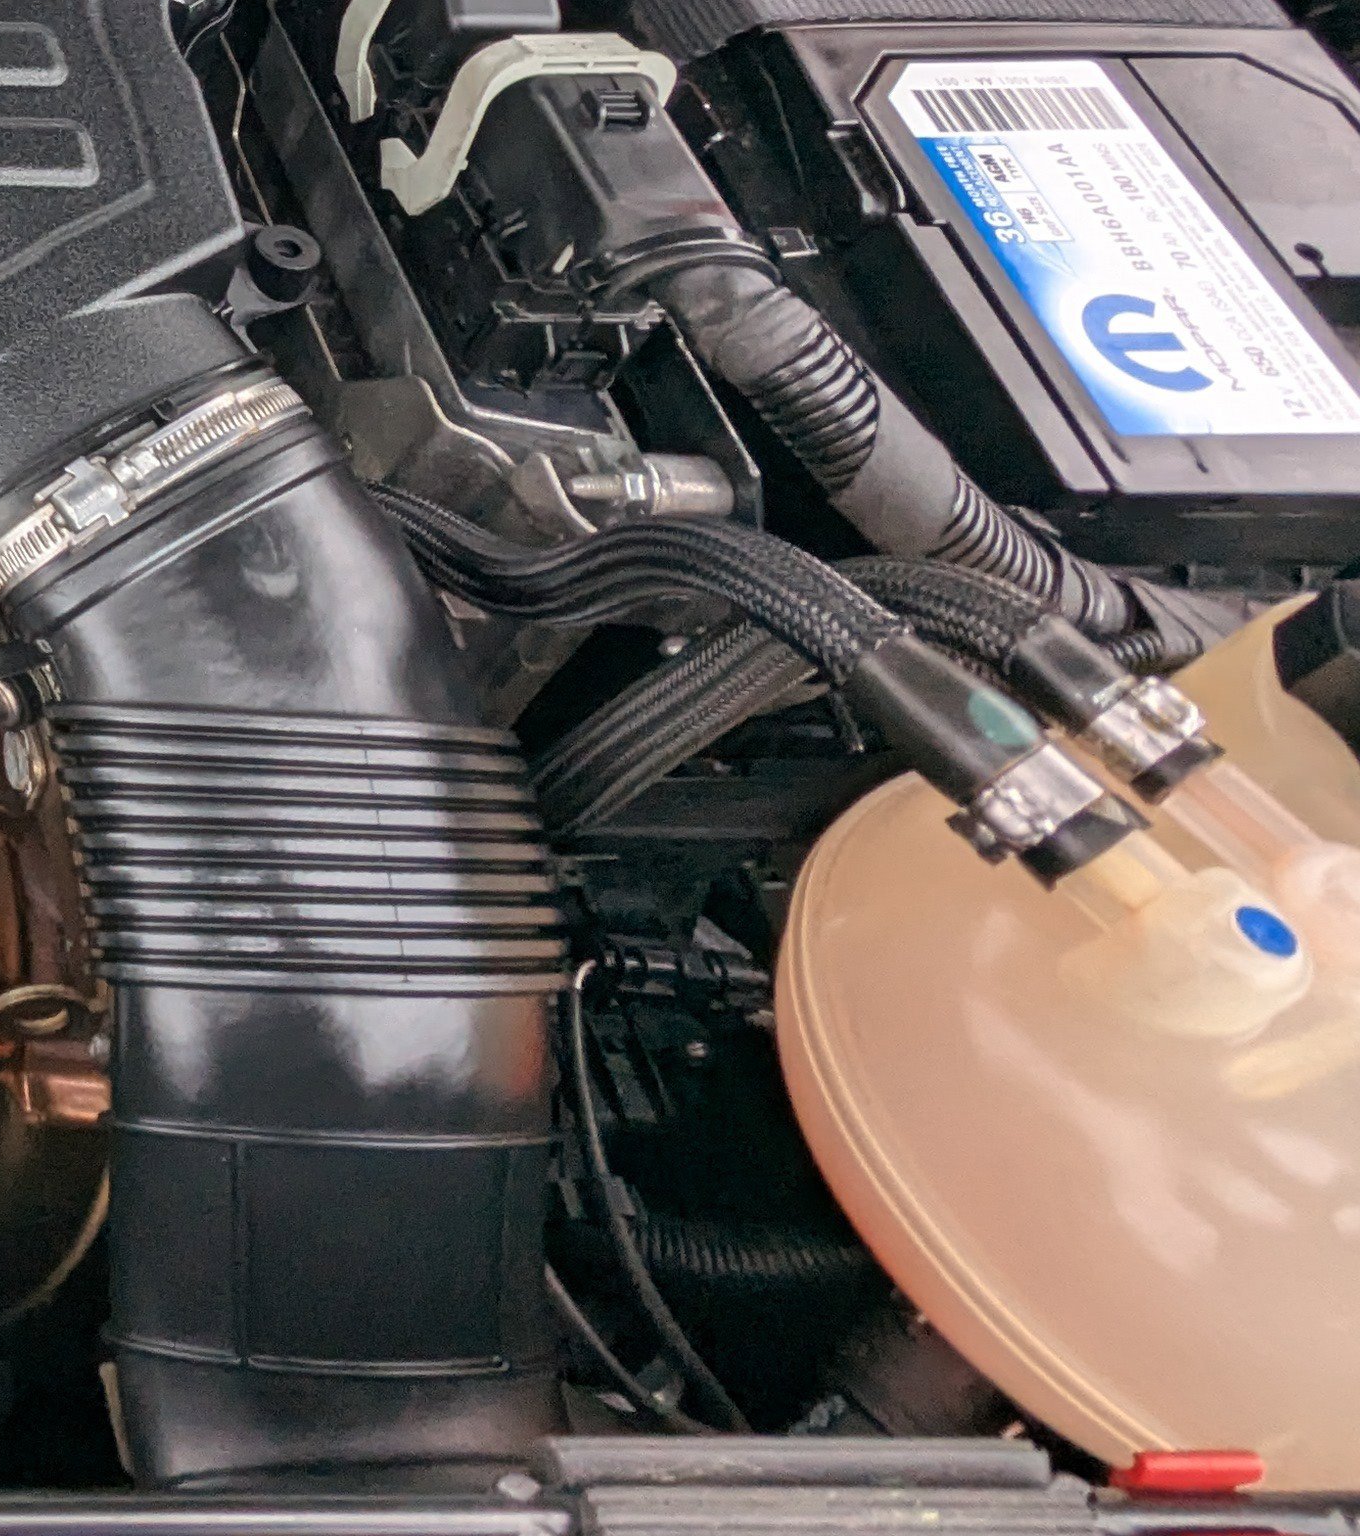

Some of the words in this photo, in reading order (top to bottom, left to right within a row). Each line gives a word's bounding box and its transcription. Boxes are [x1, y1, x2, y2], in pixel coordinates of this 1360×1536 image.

[934, 145, 960, 167] FREE
[976, 153, 1011, 182] AGM
[998, 157, 1024, 178] TYPE
[952, 169, 987, 206] MONTH
[1111, 175, 1148, 201] 100
[1015, 207, 1039, 224] H6
[1025, 196, 1050, 214] SIZE
[1043, 142, 1156, 271] BBH6A001AA
[980, 211, 1028, 243] 36
[1167, 251, 1199, 269] 70
[1240, 346, 1283, 376] 650
